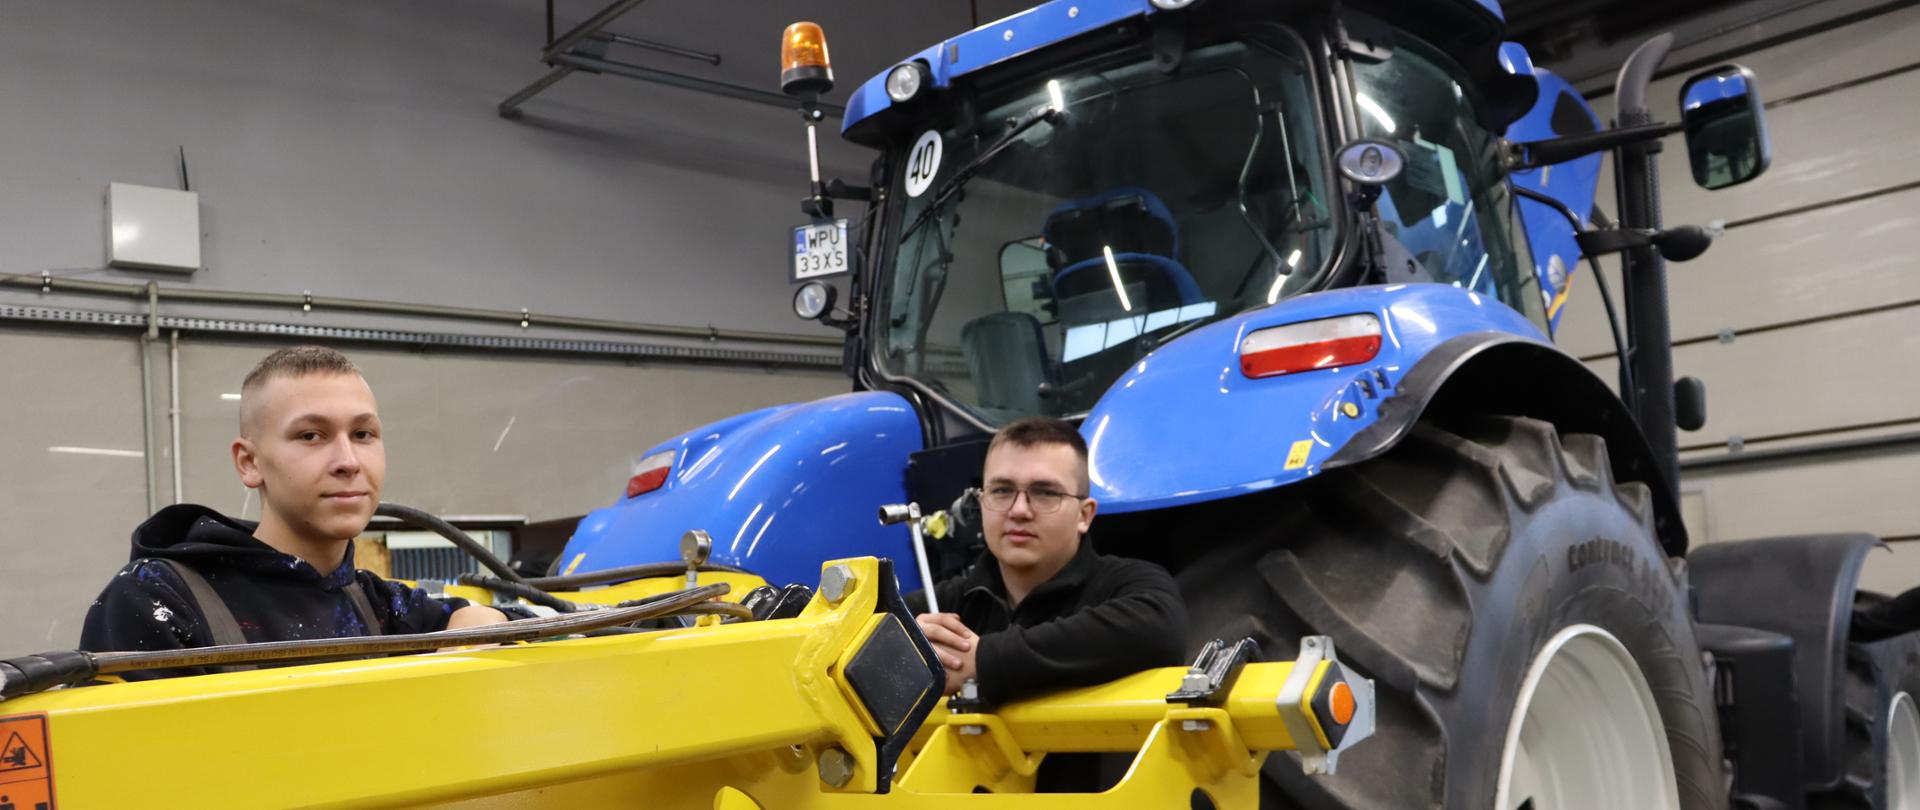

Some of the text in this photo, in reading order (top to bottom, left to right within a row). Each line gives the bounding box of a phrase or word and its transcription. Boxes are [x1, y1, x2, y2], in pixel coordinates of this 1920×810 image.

[910, 139, 935, 184] 40
[808, 229, 840, 248] WPU
[800, 250, 844, 273] 33XS
